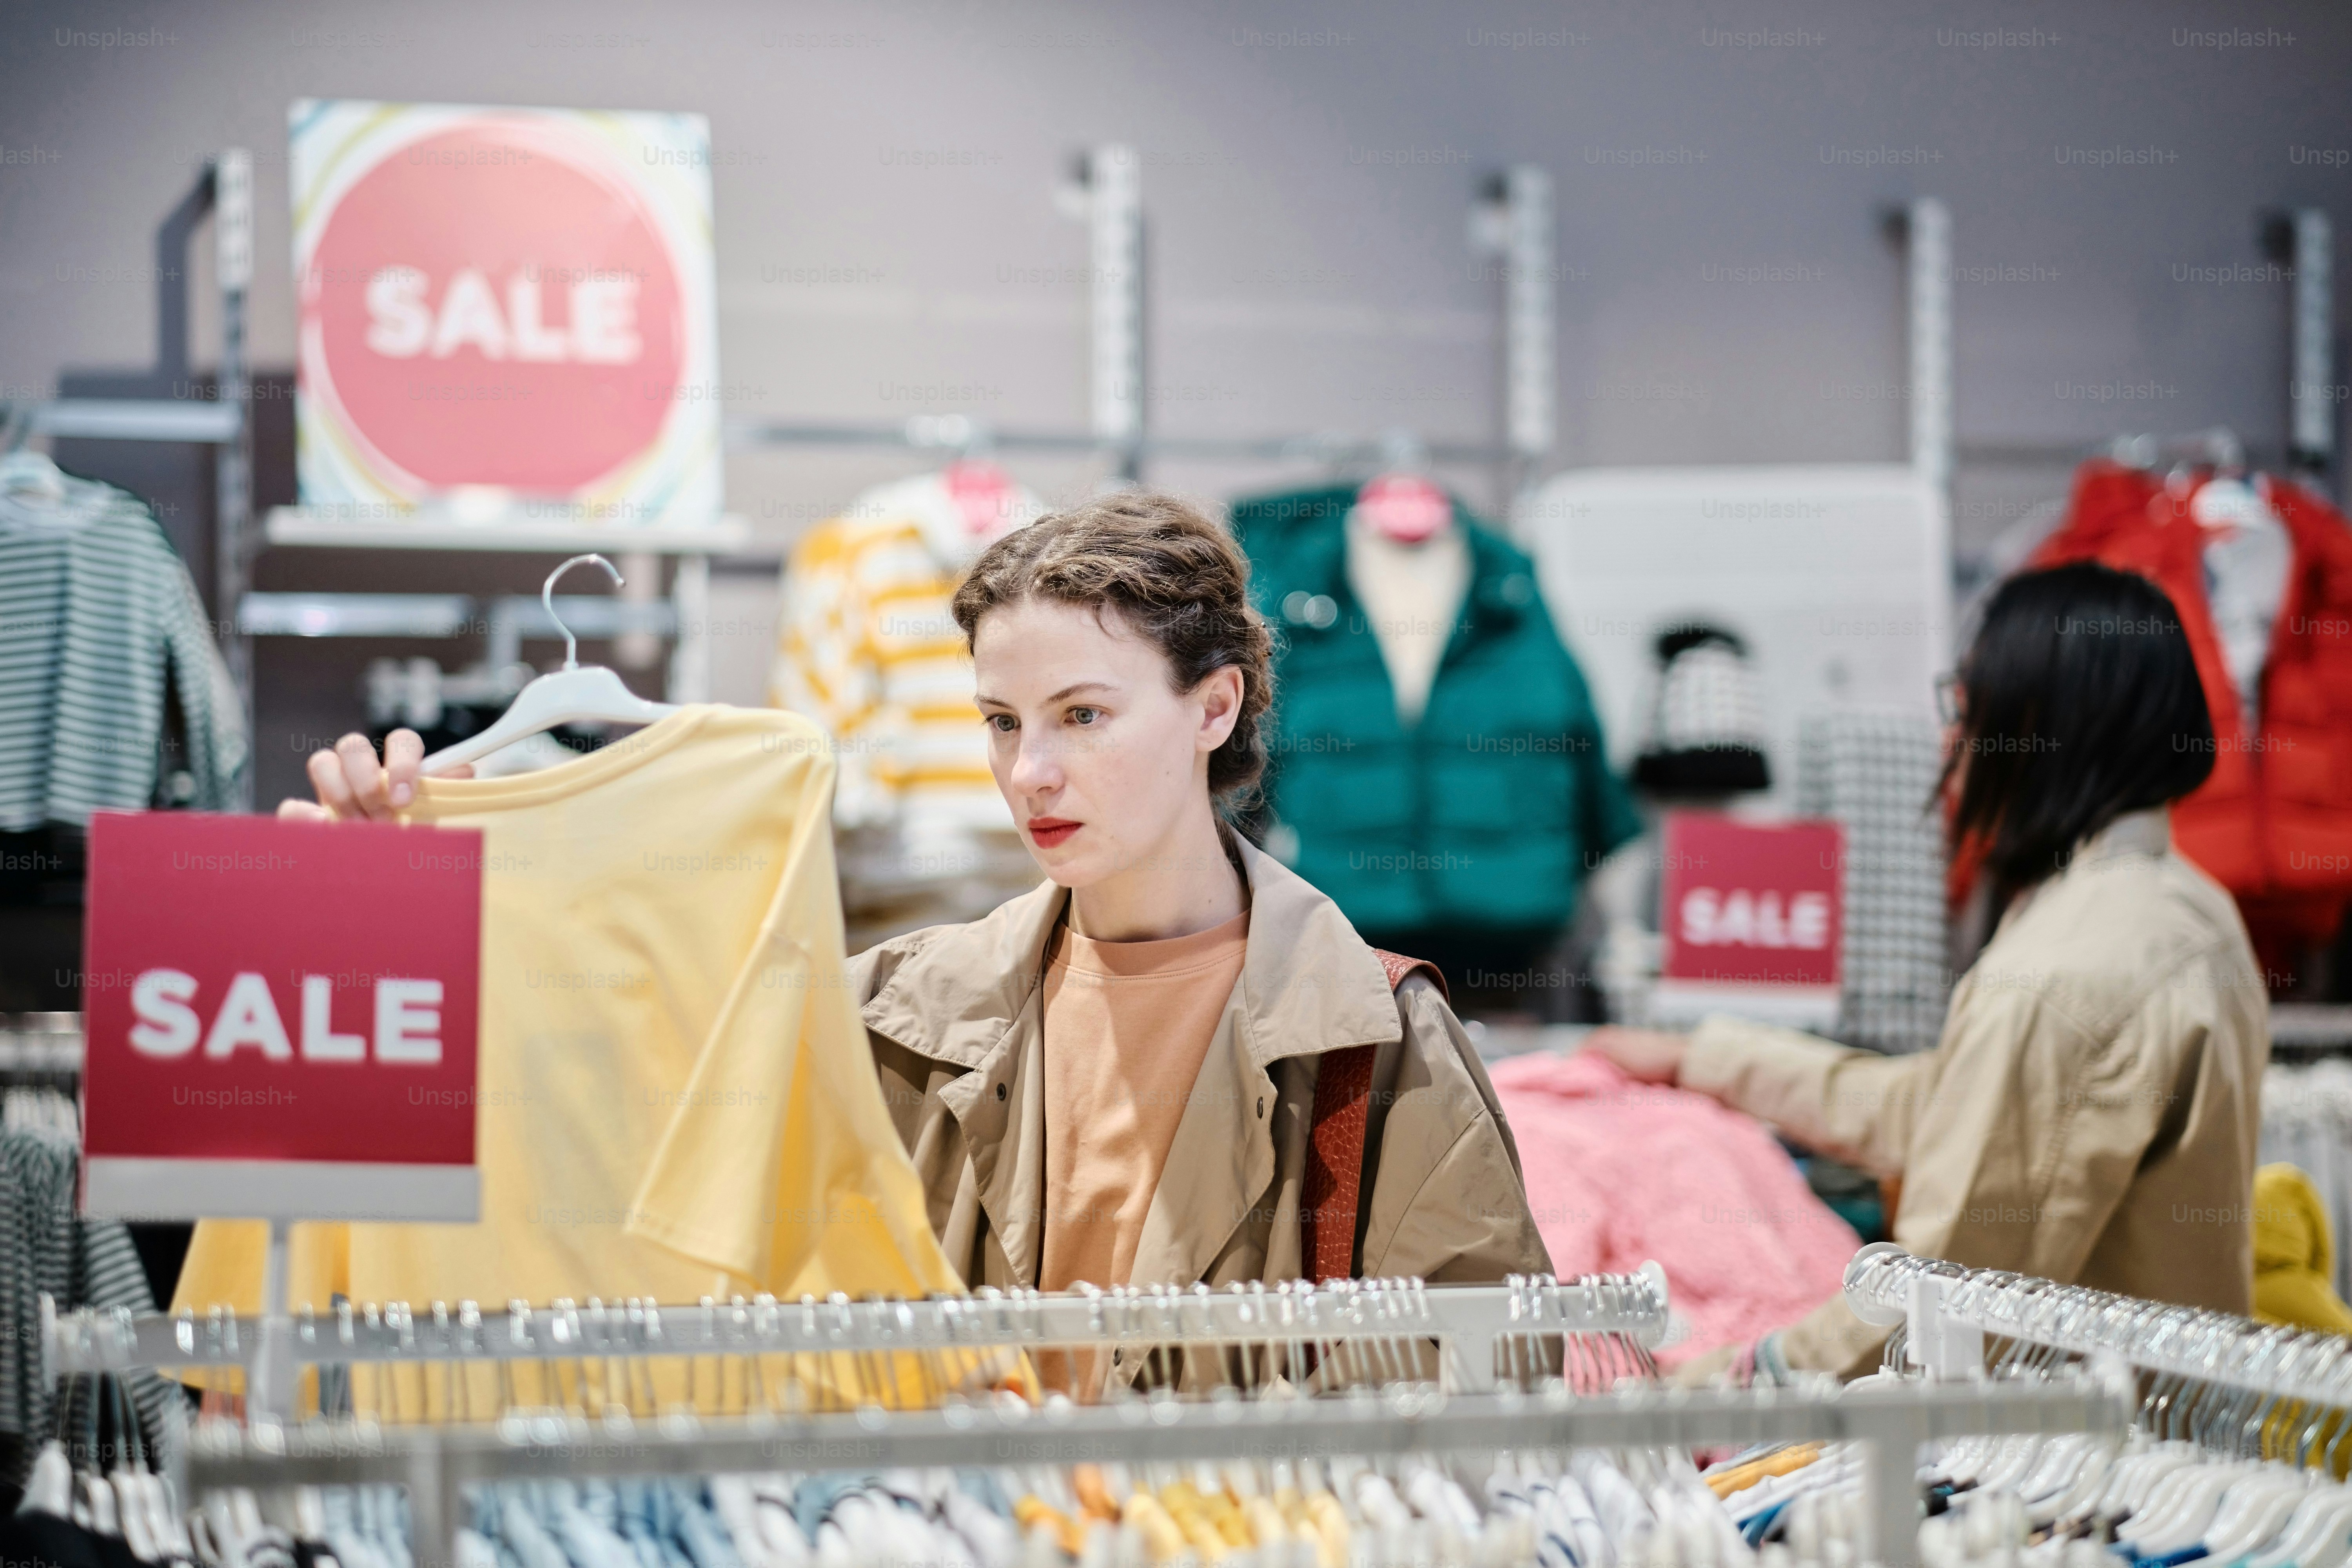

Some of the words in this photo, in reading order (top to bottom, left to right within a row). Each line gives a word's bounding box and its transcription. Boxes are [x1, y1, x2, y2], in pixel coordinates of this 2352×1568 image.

[366, 264, 642, 364] SALE
[1681, 887, 1829, 949] SALE
[130, 969, 443, 1064] SALE
